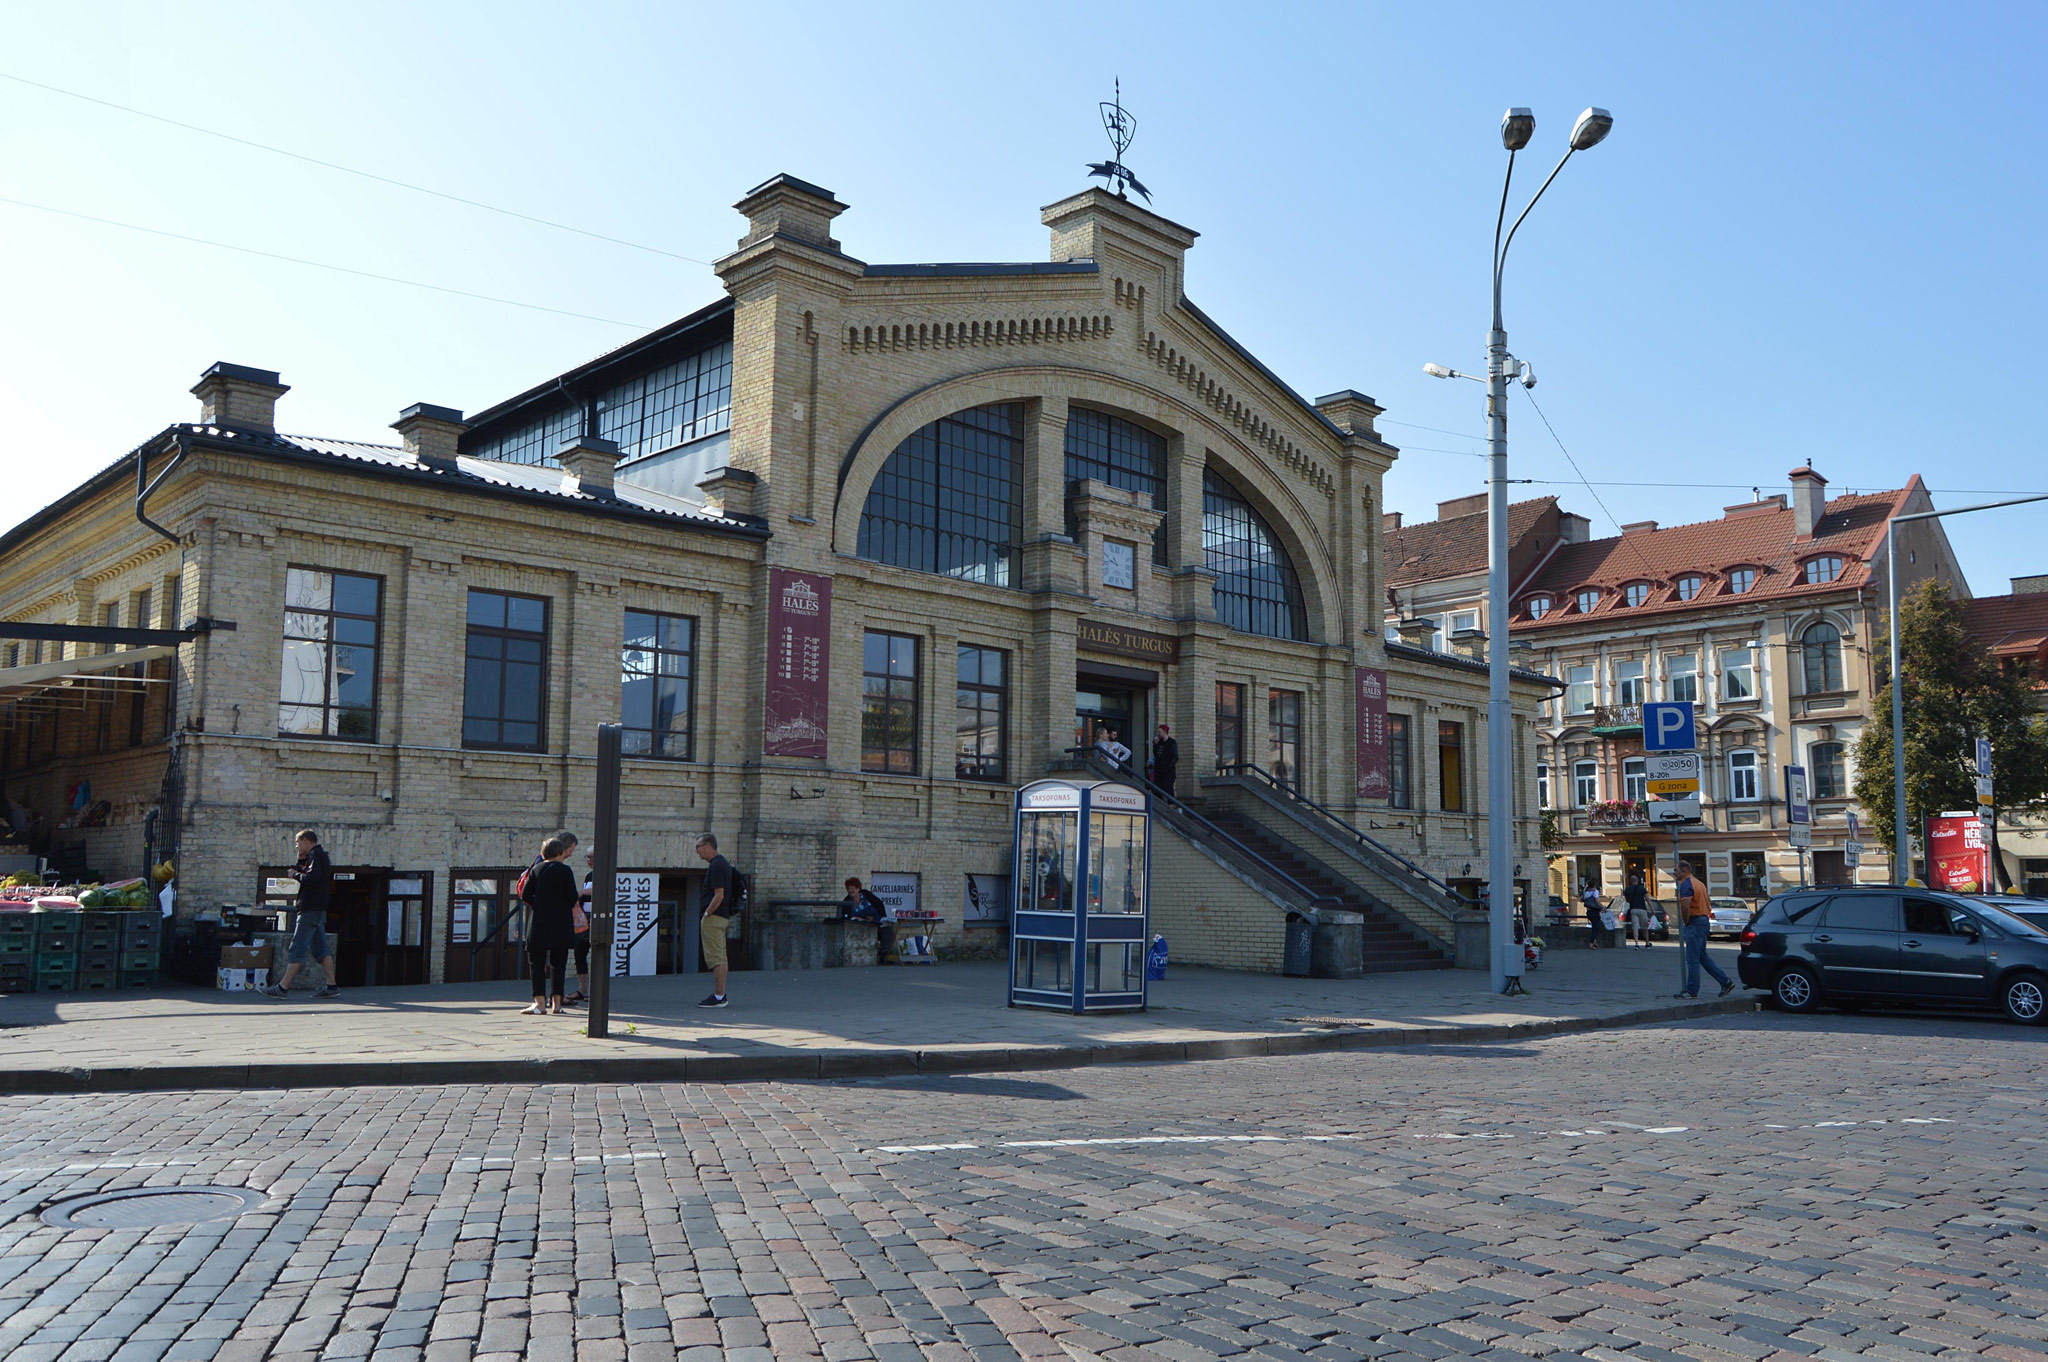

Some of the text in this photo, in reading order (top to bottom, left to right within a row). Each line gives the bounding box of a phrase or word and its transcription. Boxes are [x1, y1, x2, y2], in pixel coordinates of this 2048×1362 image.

[1077, 625, 1173, 654] HALĖS TURGUS
[1656, 707, 1685, 746] P
[1980, 743, 1989, 770] P
[1680, 760, 1692, 768] 50
[1649, 771, 1670, 779] 8-20h
[1658, 782, 1688, 790] G zona
[1032, 794, 1071, 802] TAKSOFONAS
[1099, 795, 1136, 805] TAKSOFONAS
[1931, 829, 1957, 838] Estrella
[634, 877, 651, 932] PREKĖS
[614, 877, 631, 977] ANCELIARINĖS
